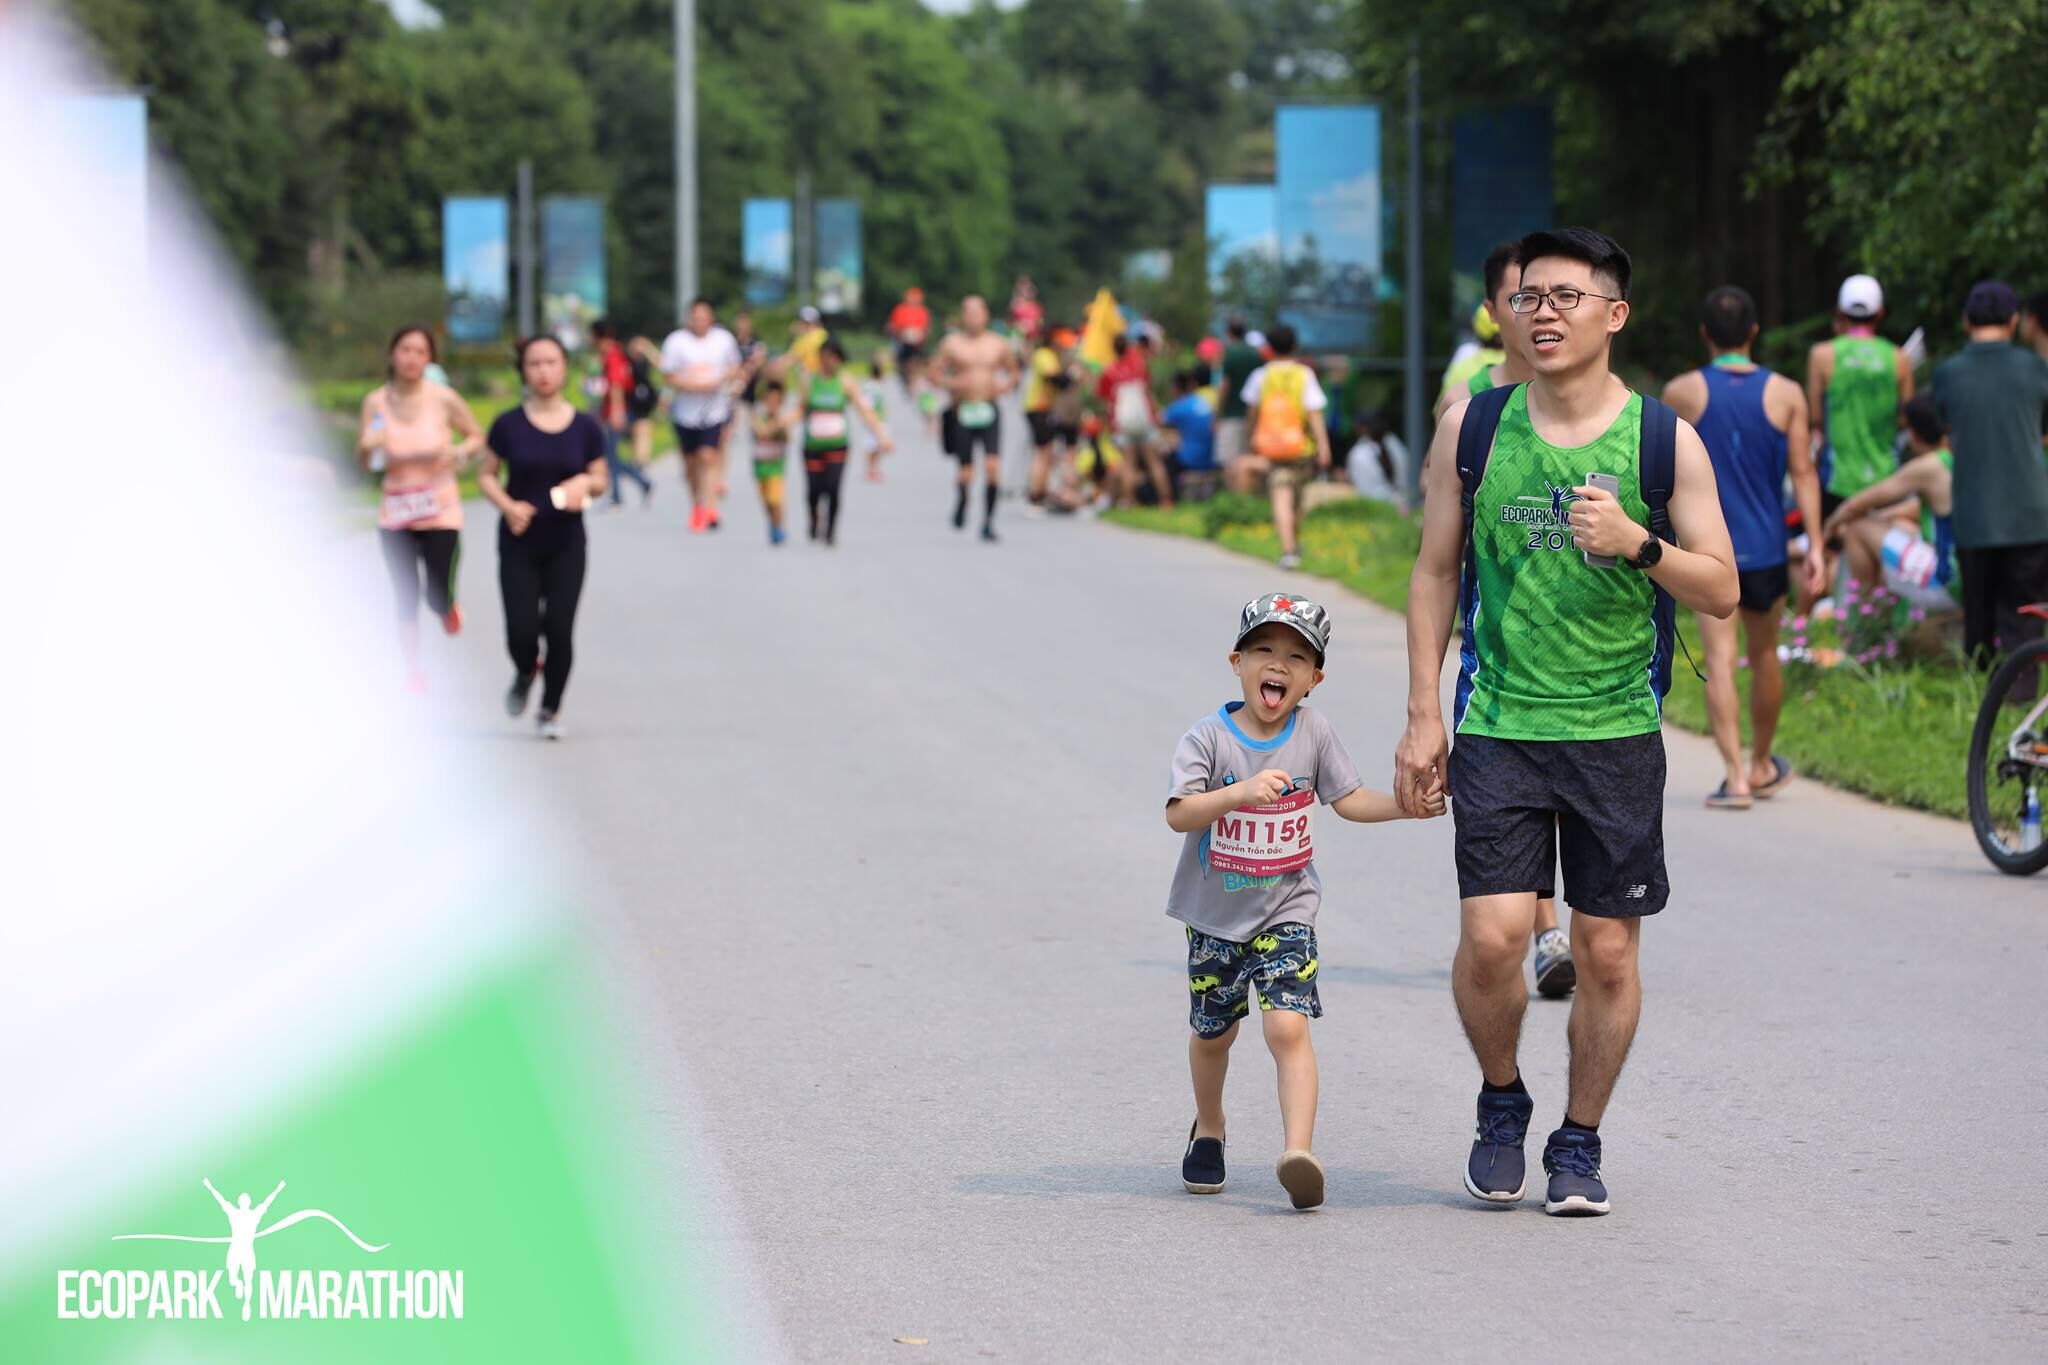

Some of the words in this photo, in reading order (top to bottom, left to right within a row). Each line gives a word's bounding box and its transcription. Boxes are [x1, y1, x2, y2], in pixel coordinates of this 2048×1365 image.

[1501, 505, 1551, 524] ECOPARK
[1527, 531, 1576, 551] 201
[1279, 801, 1296, 811] 2019
[1217, 814, 1308, 843] M1159
